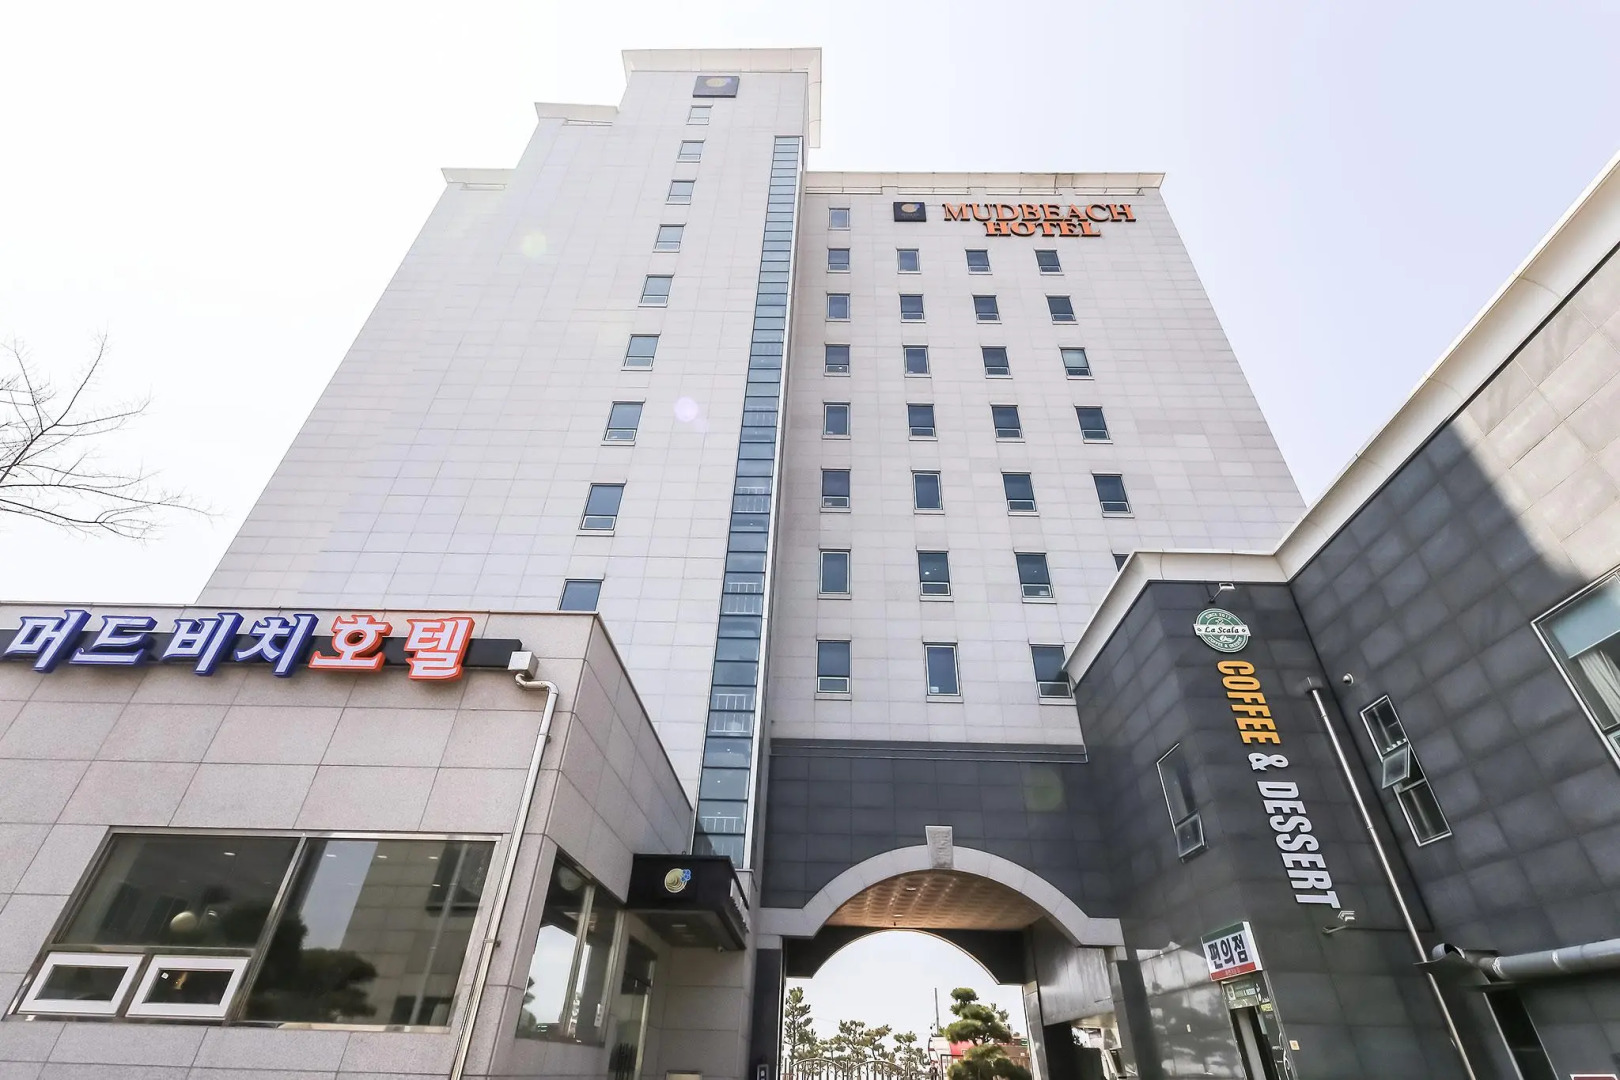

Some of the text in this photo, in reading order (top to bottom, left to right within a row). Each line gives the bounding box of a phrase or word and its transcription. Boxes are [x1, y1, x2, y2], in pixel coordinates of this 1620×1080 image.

[942, 203, 1137, 222] MUDBEACH
[983, 221, 1101, 238] HOTEL
[1217, 626, 1240, 634] Scala
[1, 608, 475, 682] 머드비치호텔
[1217, 660, 1341, 908] COFFEE & DESSERT
[1208, 933, 1249, 970] 편의점
